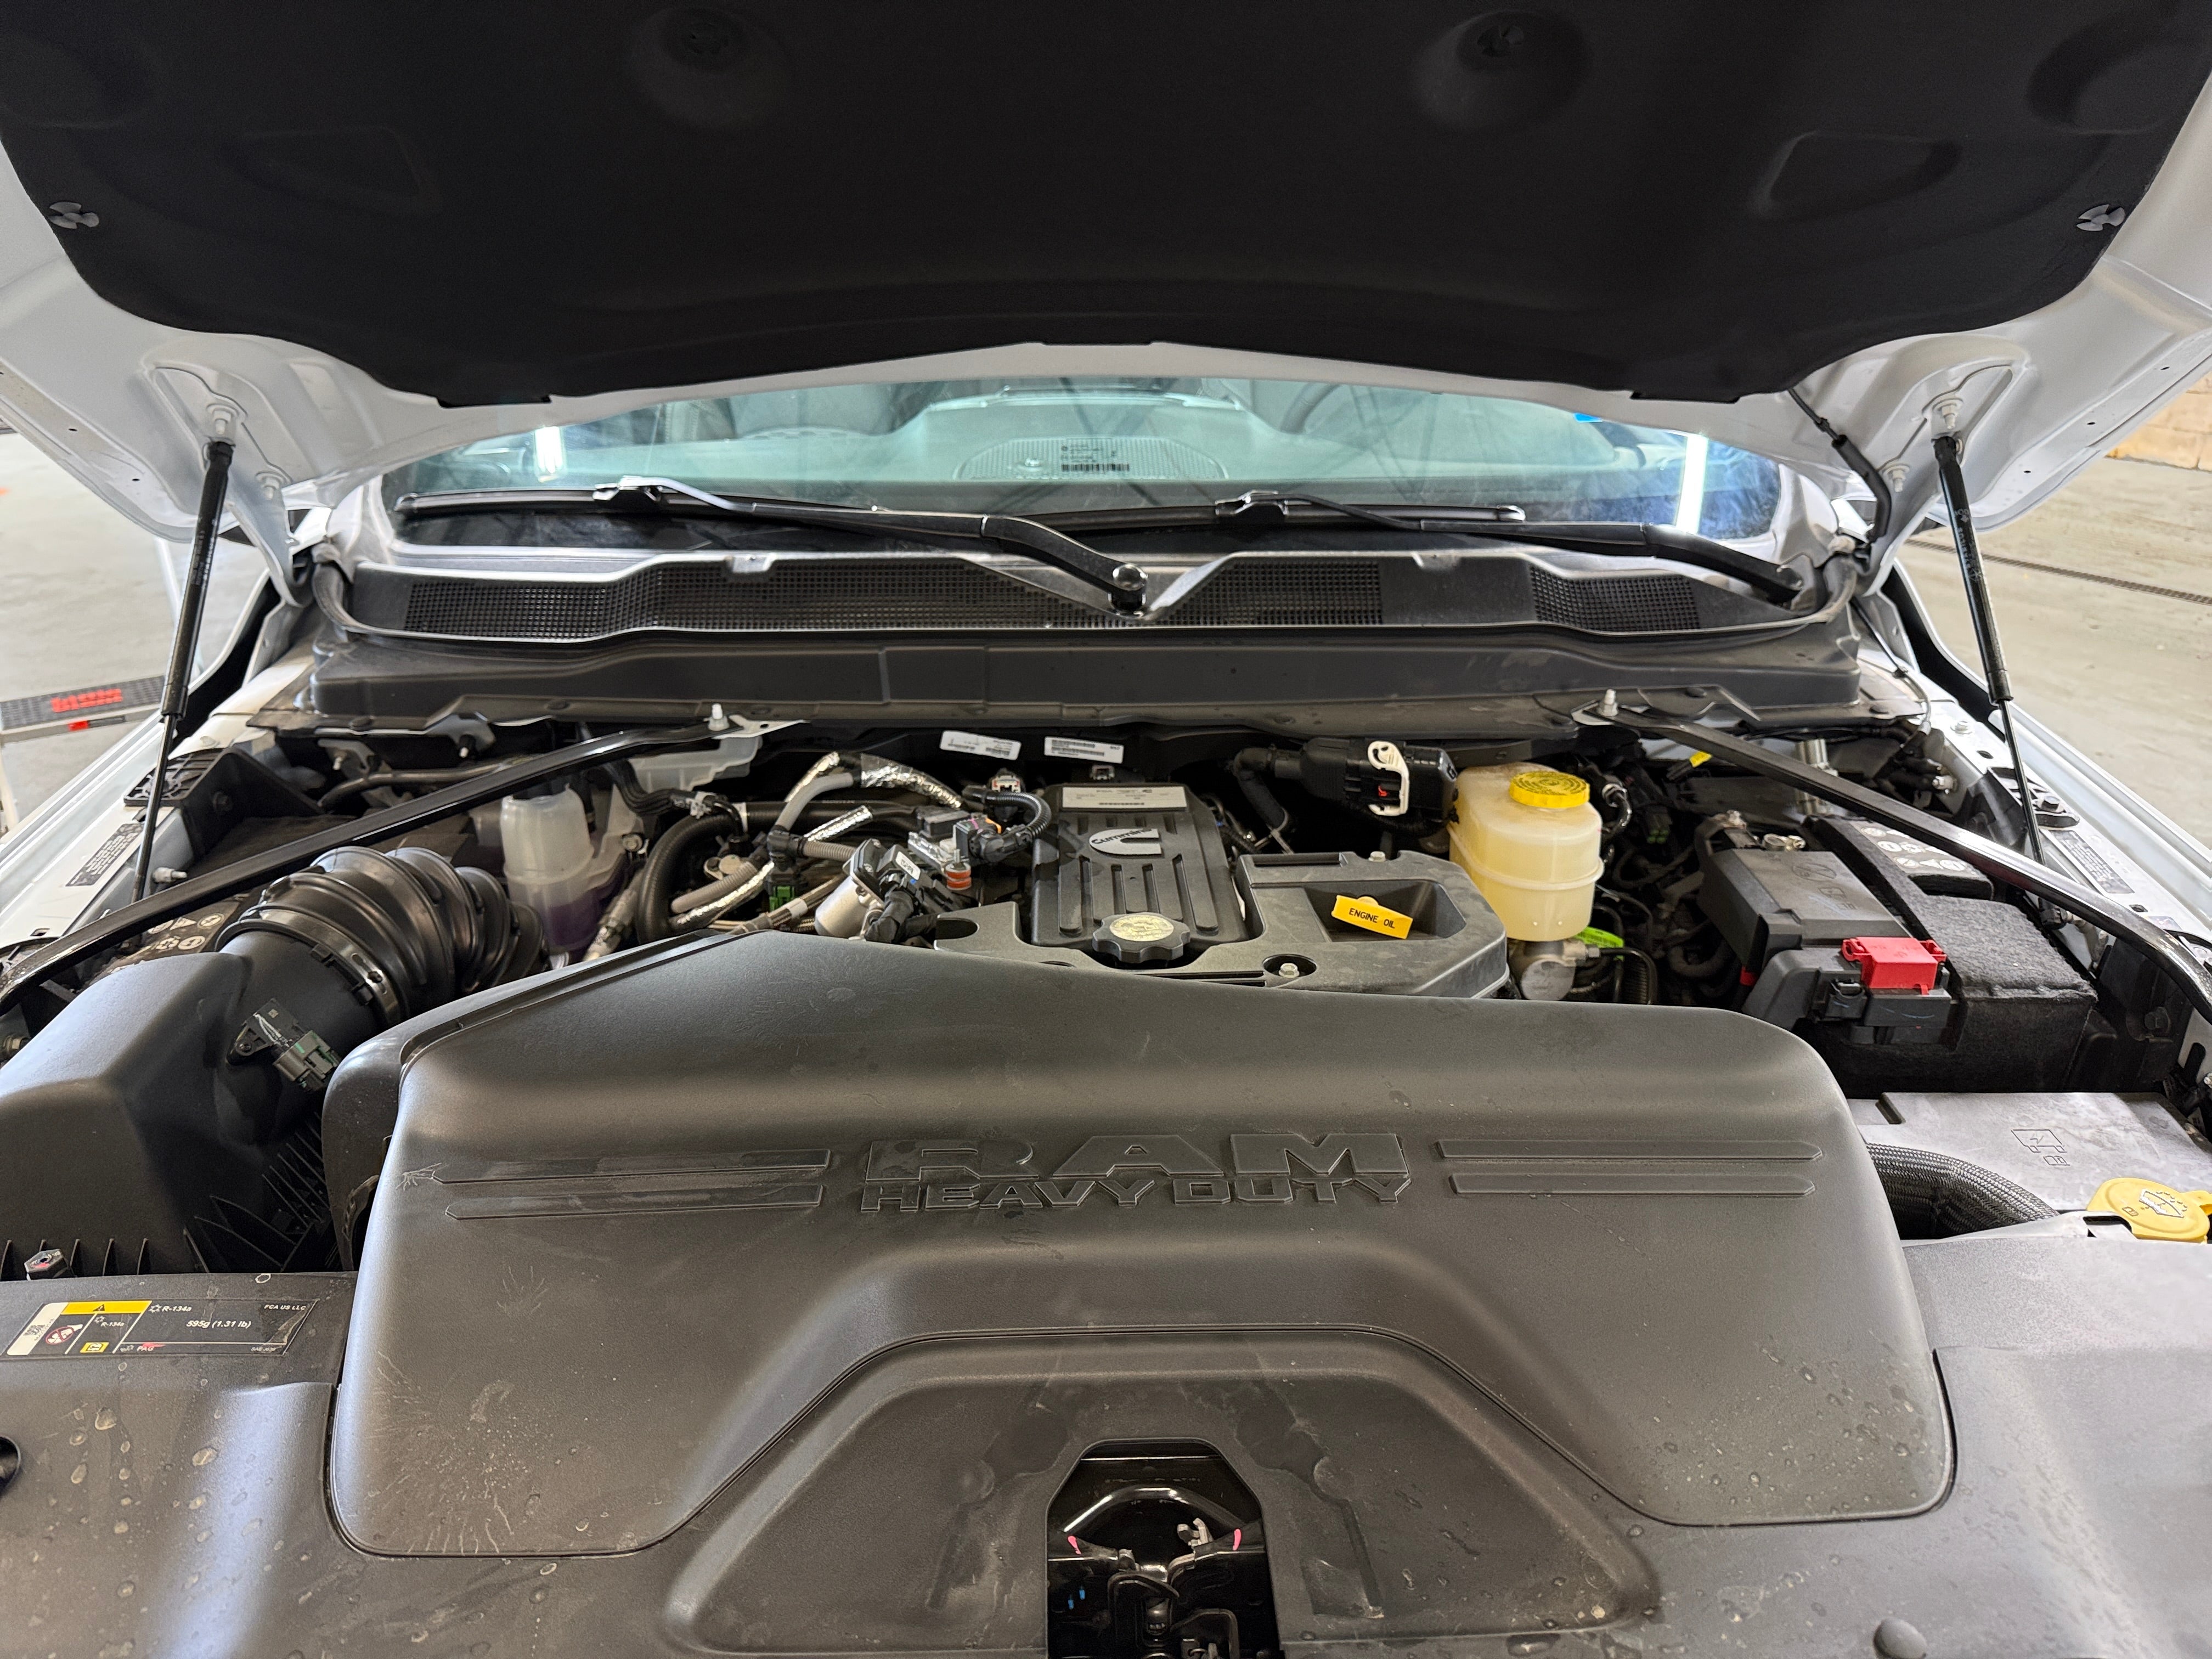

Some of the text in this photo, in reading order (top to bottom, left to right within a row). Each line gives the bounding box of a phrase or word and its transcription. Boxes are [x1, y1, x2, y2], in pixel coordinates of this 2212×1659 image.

[1348, 907, 1396, 929] ENGINE OIL
[865, 1132, 1409, 1183] RAM
[861, 1177, 1412, 1212] HEAVY DUTY
[186, 1320, 252, 1329] 595g (1.31 lb)
